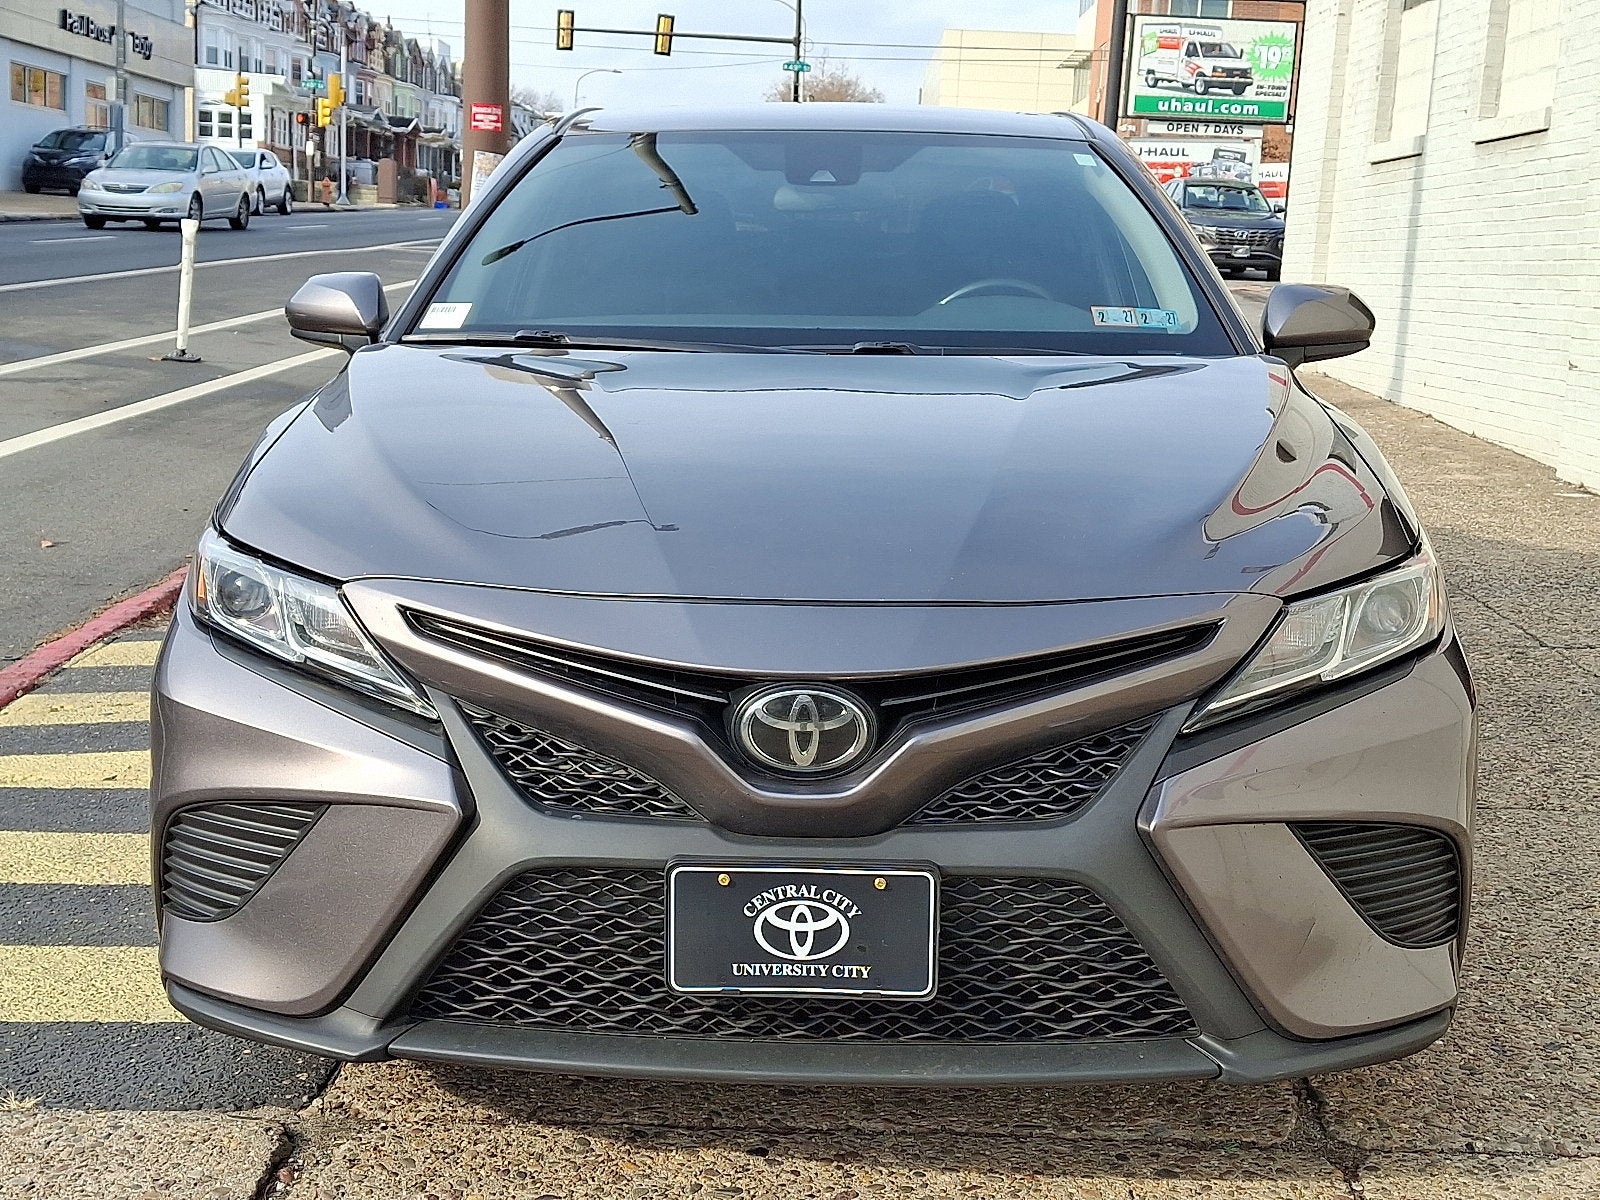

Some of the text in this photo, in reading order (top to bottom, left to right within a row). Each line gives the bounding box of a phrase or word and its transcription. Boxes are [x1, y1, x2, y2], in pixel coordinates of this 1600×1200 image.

[61, 9, 89, 36] Paul
[1158, 98, 1258, 114] uhaul.com
[1166, 122, 1244, 135] OPEN 7 DAYS
[743, 884, 863, 919] CENTRAL CITY
[731, 963, 872, 979] UNIVERSITY CITY
